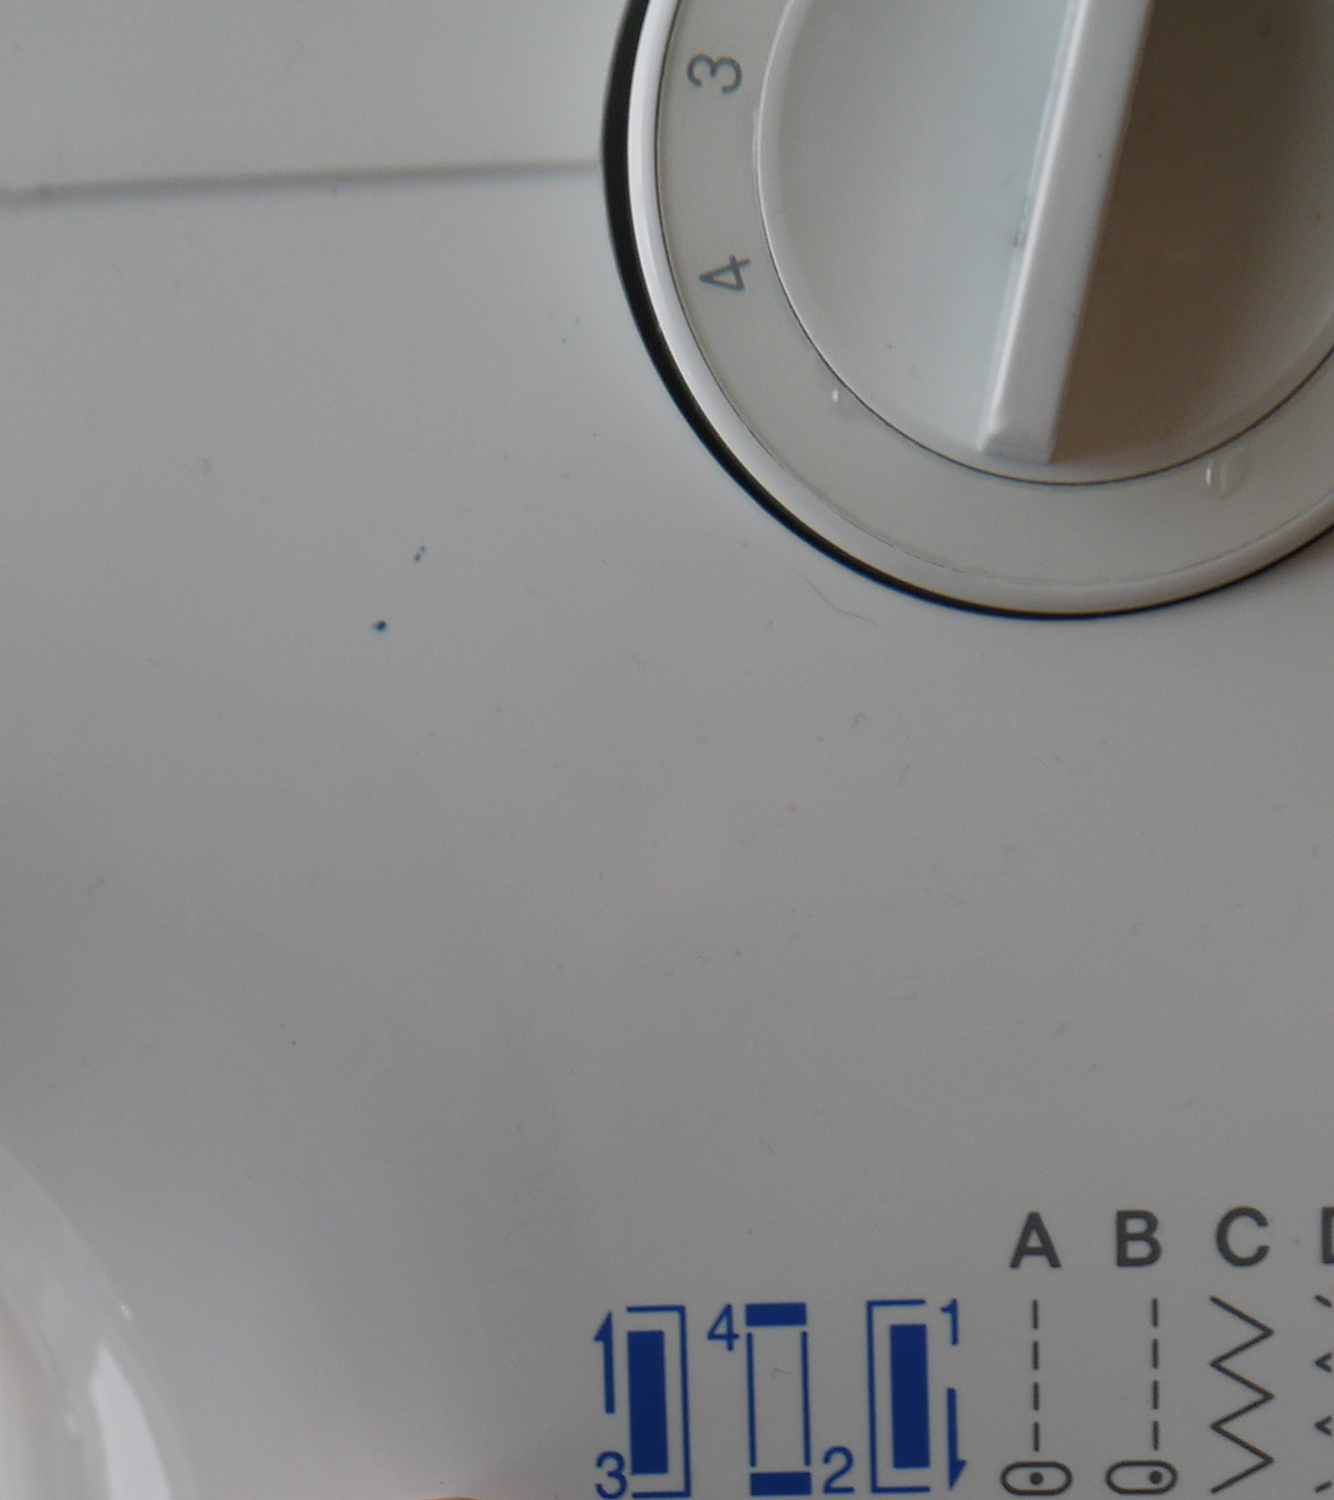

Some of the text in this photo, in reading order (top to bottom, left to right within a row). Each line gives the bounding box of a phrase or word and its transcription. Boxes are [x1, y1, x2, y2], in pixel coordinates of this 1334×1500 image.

[685, 52, 743, 96] 3
[698, 253, 752, 293] 4
[1009, 1210, 1062, 1269] A
[1115, 1209, 1162, 1268] B
[1214, 1205, 1271, 1268] C
[707, 1303, 740, 1352] 4
[940, 1298, 959, 1346] 1
[595, 1451, 628, 1500] 3
[822, 1446, 855, 1495] 2
